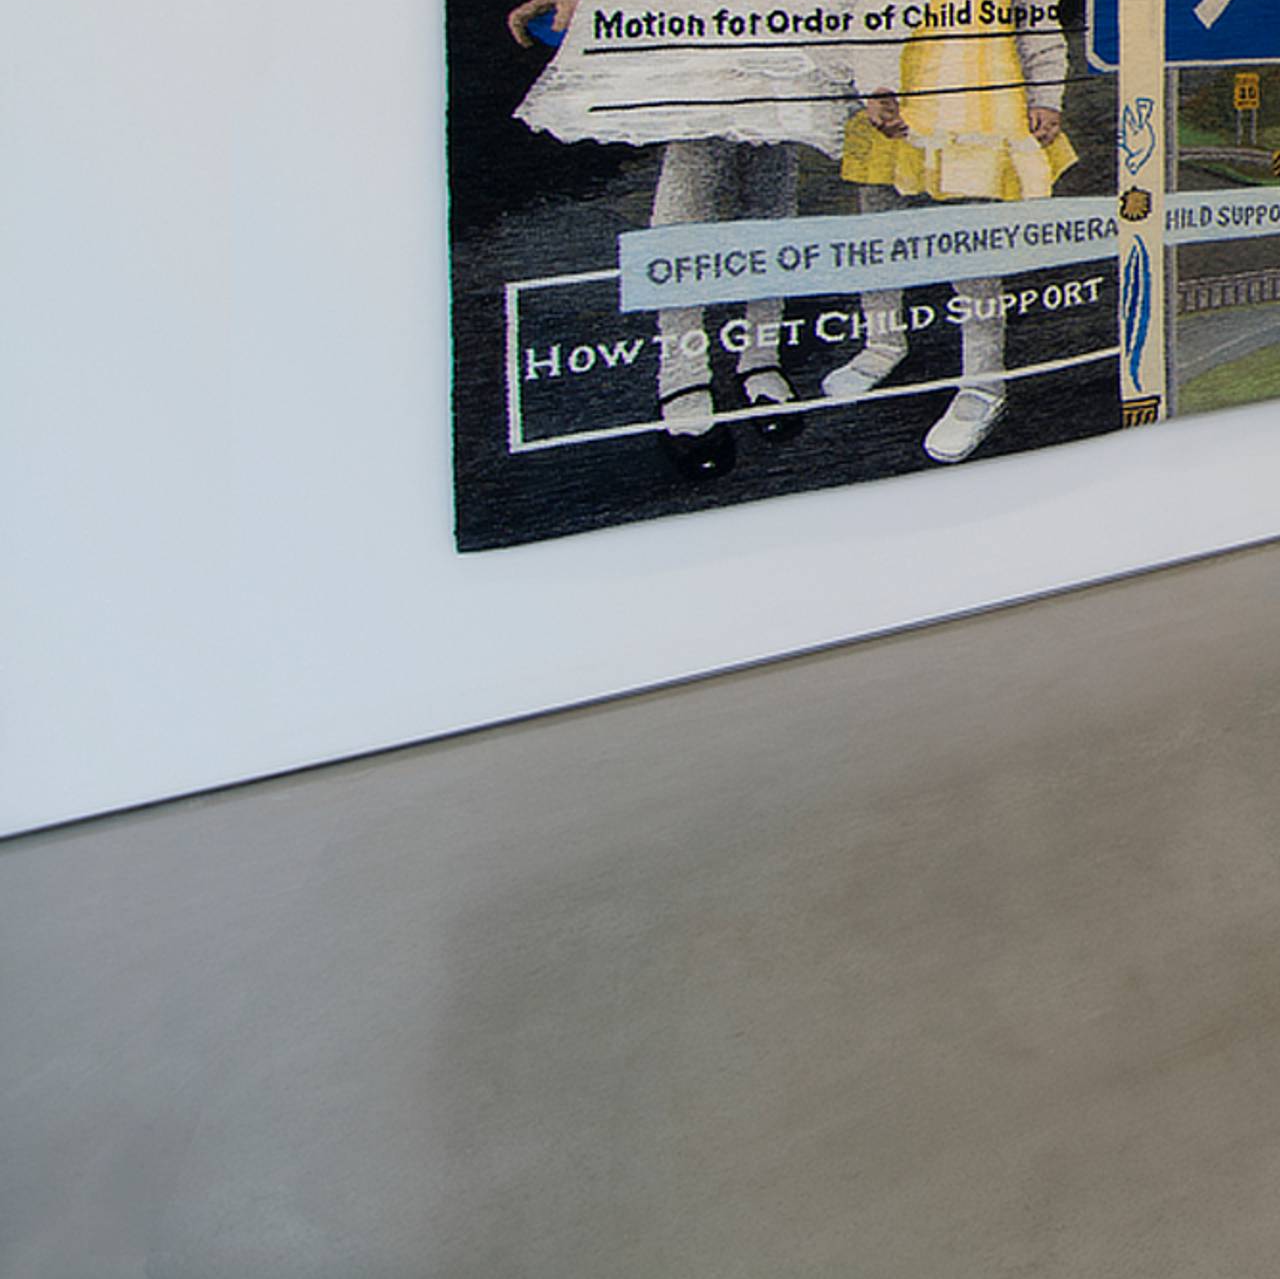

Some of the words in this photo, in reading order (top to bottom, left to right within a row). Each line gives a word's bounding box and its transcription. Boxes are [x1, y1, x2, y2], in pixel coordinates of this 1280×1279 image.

[594, 9, 705, 39] Motion
[713, 8, 762, 36] for
[864, 3, 896, 30] of
[903, 0, 972, 28] Child
[647, 251, 768, 285] OFFICE
[776, 243, 821, 273] OF
[831, 240, 885, 268] THE
[890, 223, 1020, 262] ATTORNEY
